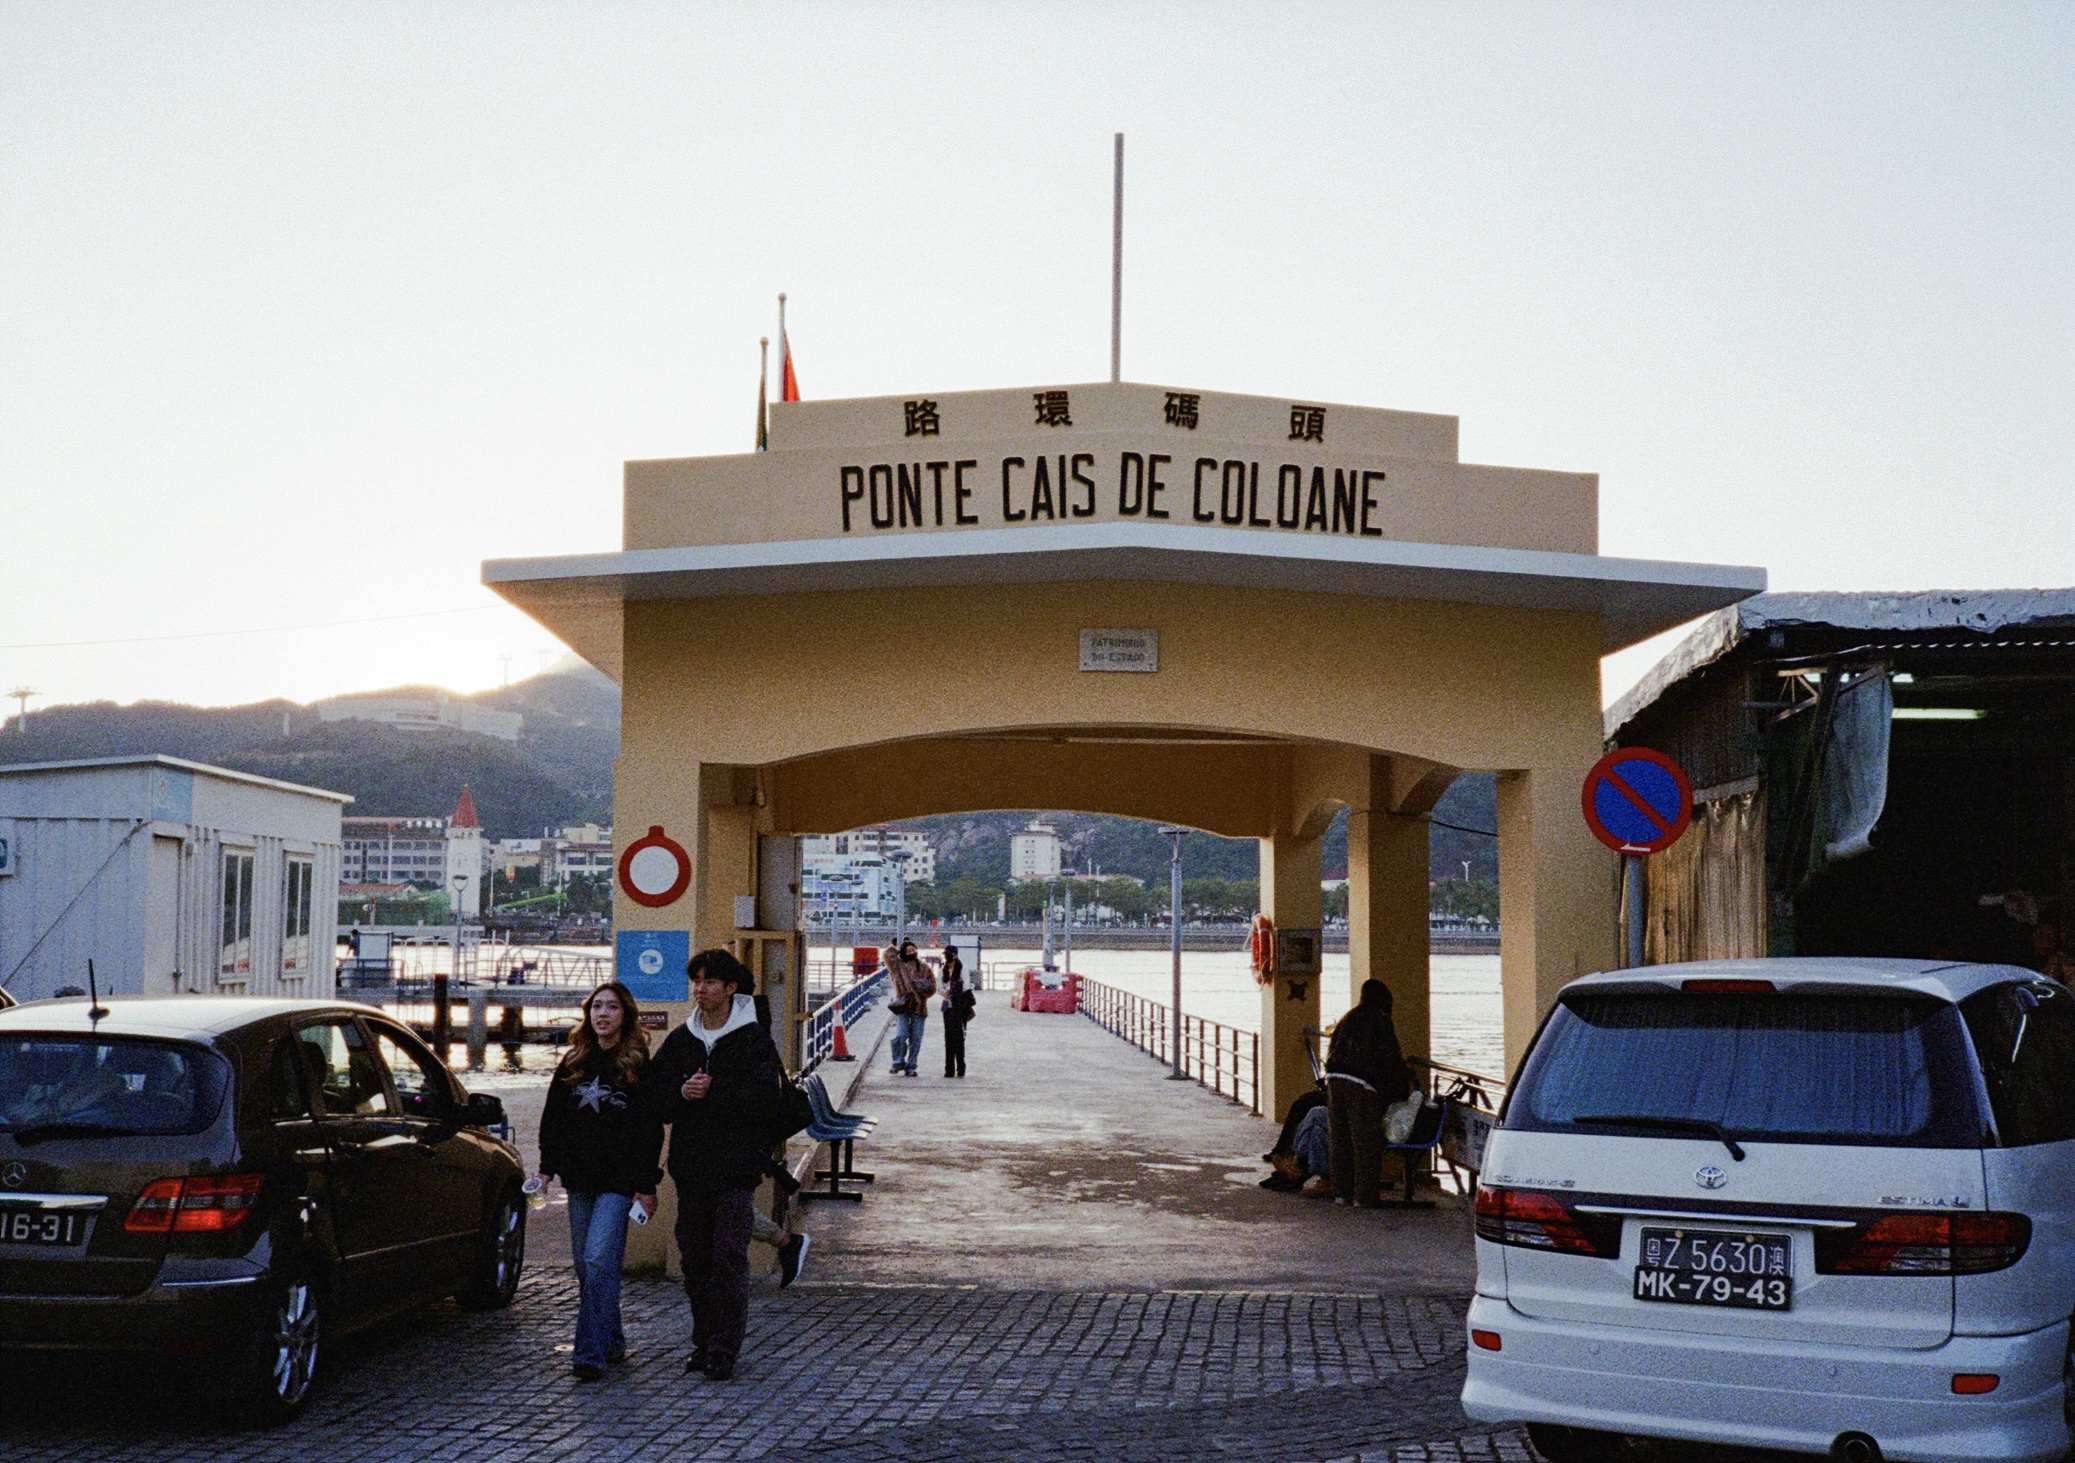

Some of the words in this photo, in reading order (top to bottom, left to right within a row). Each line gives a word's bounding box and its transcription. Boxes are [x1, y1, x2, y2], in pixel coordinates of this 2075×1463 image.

[904, 390, 1327, 444] 路環碼頭
[841, 459, 979, 532] PONTE
[1002, 453, 1096, 522] CAIS
[1119, 451, 1172, 518] DE
[1193, 457, 1386, 535] COLOANE
[1638, 1270, 1787, 1306] MK-79-43
